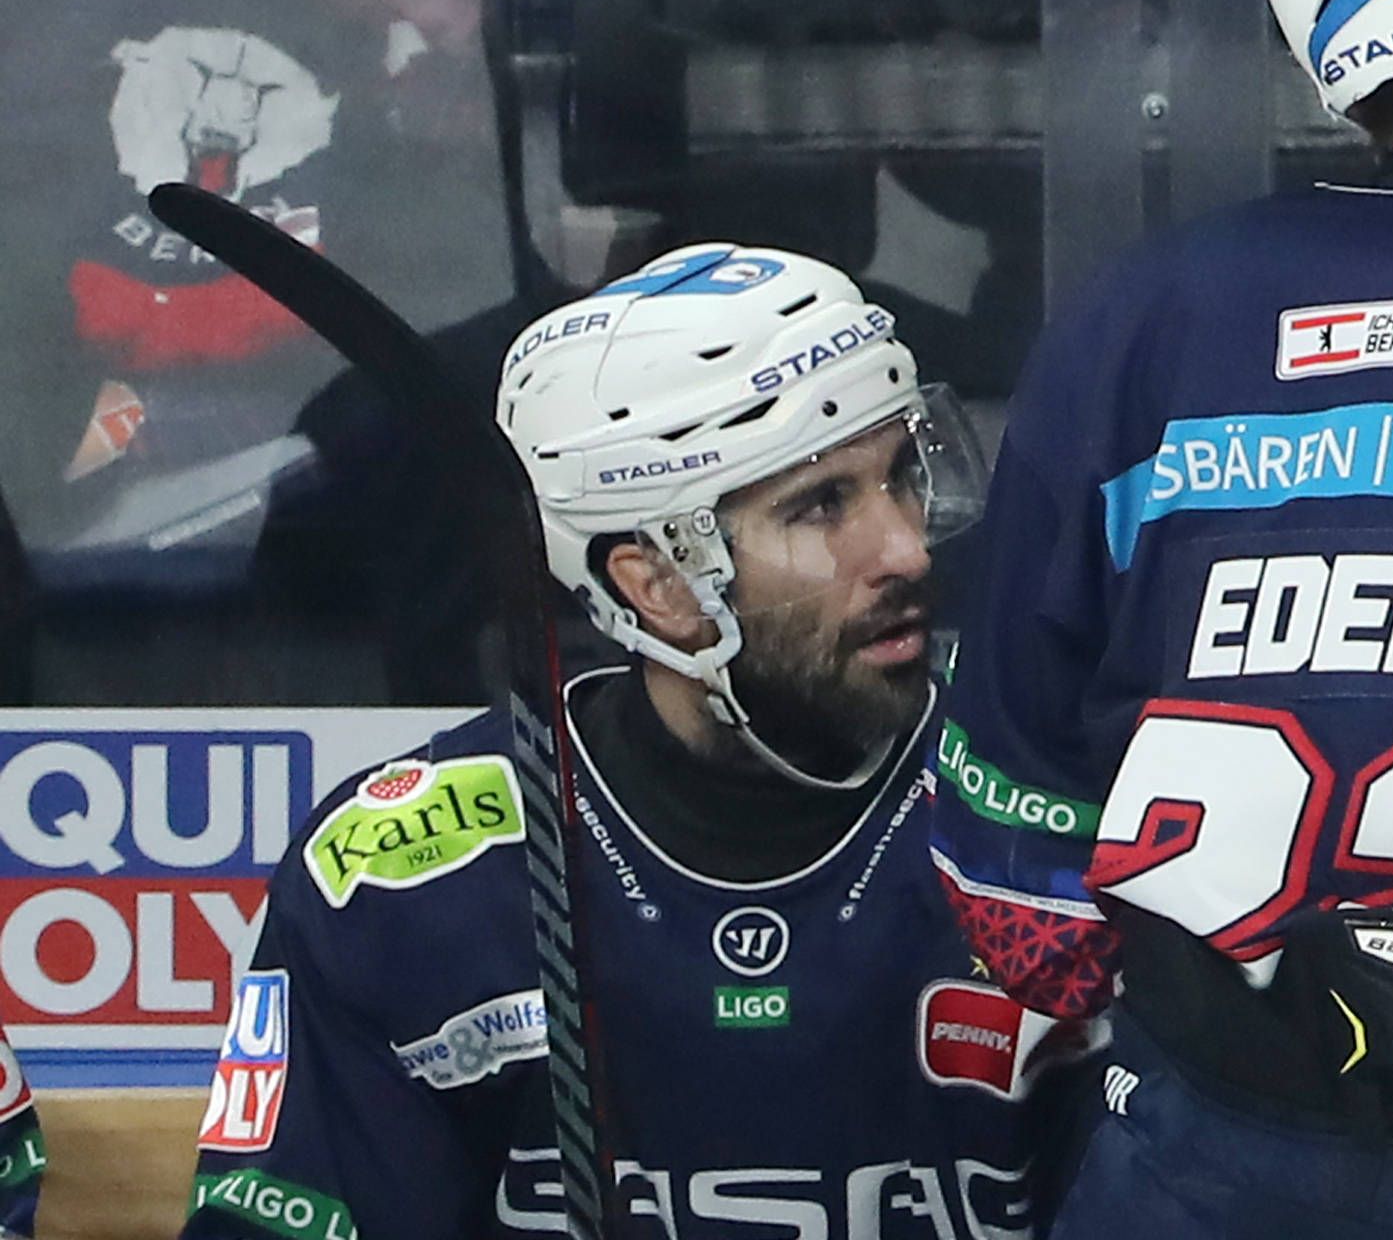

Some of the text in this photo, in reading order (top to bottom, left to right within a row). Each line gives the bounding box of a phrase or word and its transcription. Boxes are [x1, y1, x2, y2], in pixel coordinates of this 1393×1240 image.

[599, 450, 722, 485] STADLER
[1150, 424, 1357, 501] SBÄREN
[324, 783, 506, 881] Karls
[985, 781, 1077, 833] LIGO
[407, 844, 442, 868] 1921
[717, 994, 787, 1019] LIGO
[223, 1175, 315, 1229] LIGO
